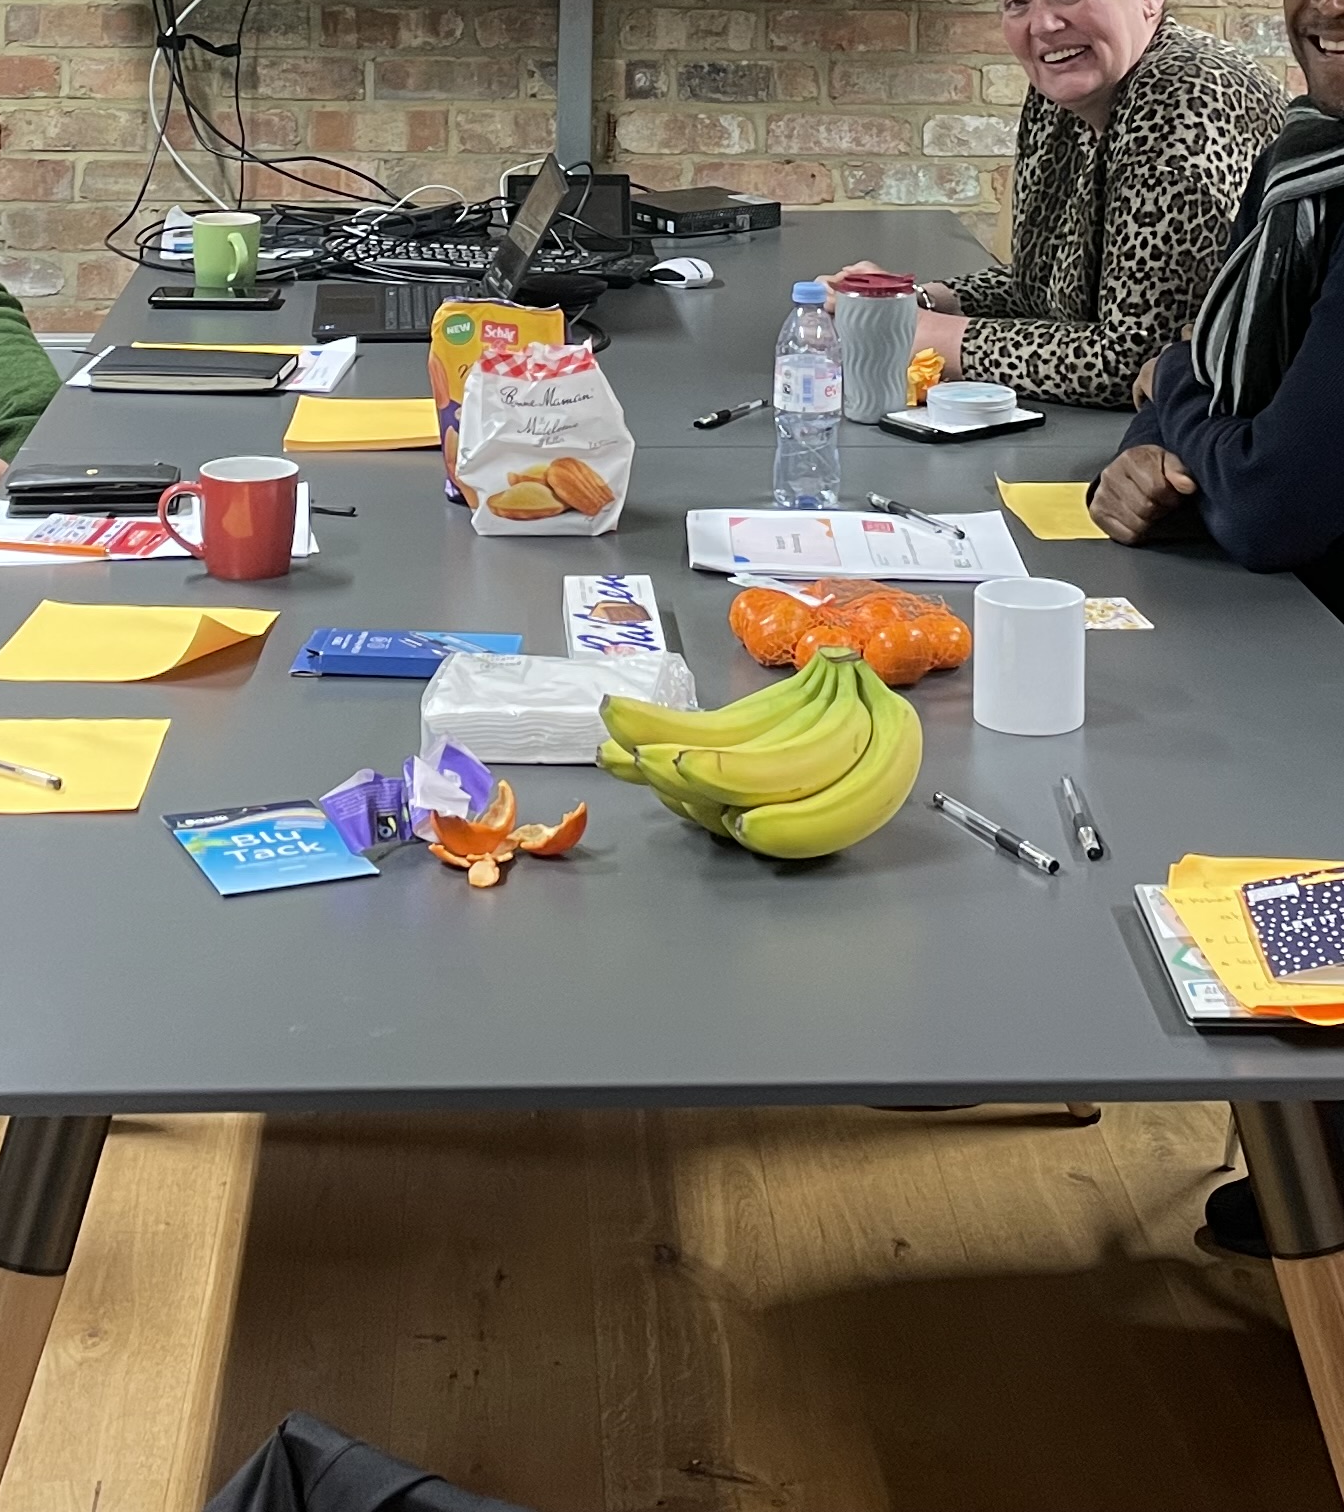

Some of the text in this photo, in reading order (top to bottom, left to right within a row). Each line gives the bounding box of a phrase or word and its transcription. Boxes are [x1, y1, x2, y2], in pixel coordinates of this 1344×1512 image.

[446, 322, 471, 334] NEW
[230, 830, 302, 848] Blu
[223, 841, 326, 863] Tack
[1280, 917, 1315, 932] LET
[1319, 914, 1337, 926] IT
